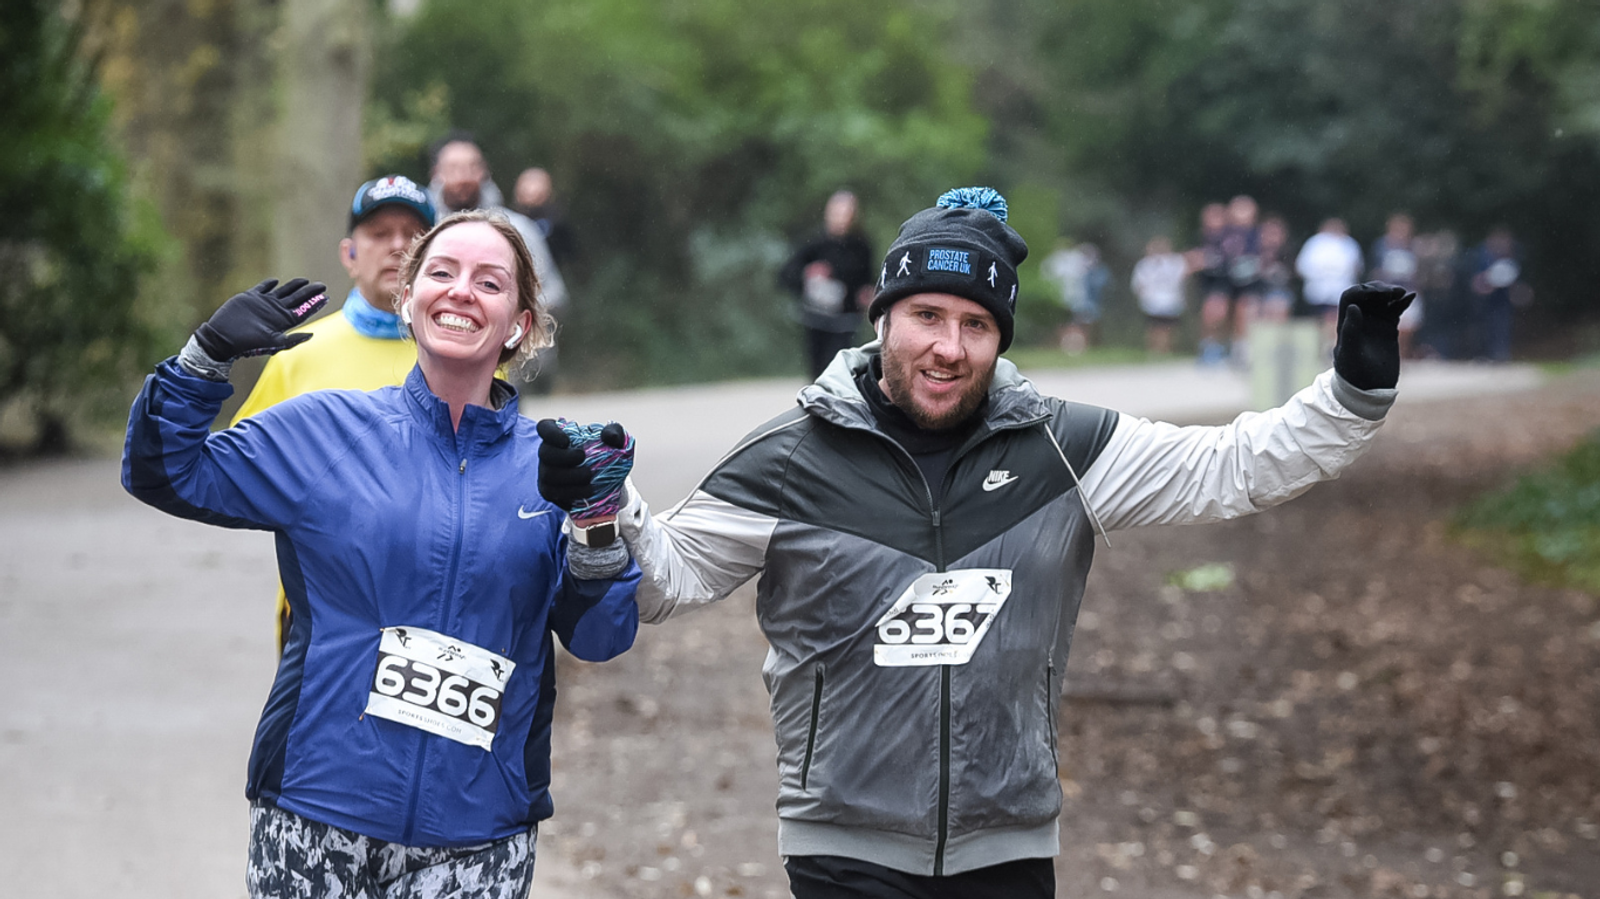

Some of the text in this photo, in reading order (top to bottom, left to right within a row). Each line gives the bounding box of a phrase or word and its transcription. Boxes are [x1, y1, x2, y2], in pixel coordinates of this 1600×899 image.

[929, 249, 969, 263] PROSTATE
[927, 259, 971, 275] CANCER UK
[988, 469, 1010, 483] NIKE
[375, 655, 500, 728] 6366
